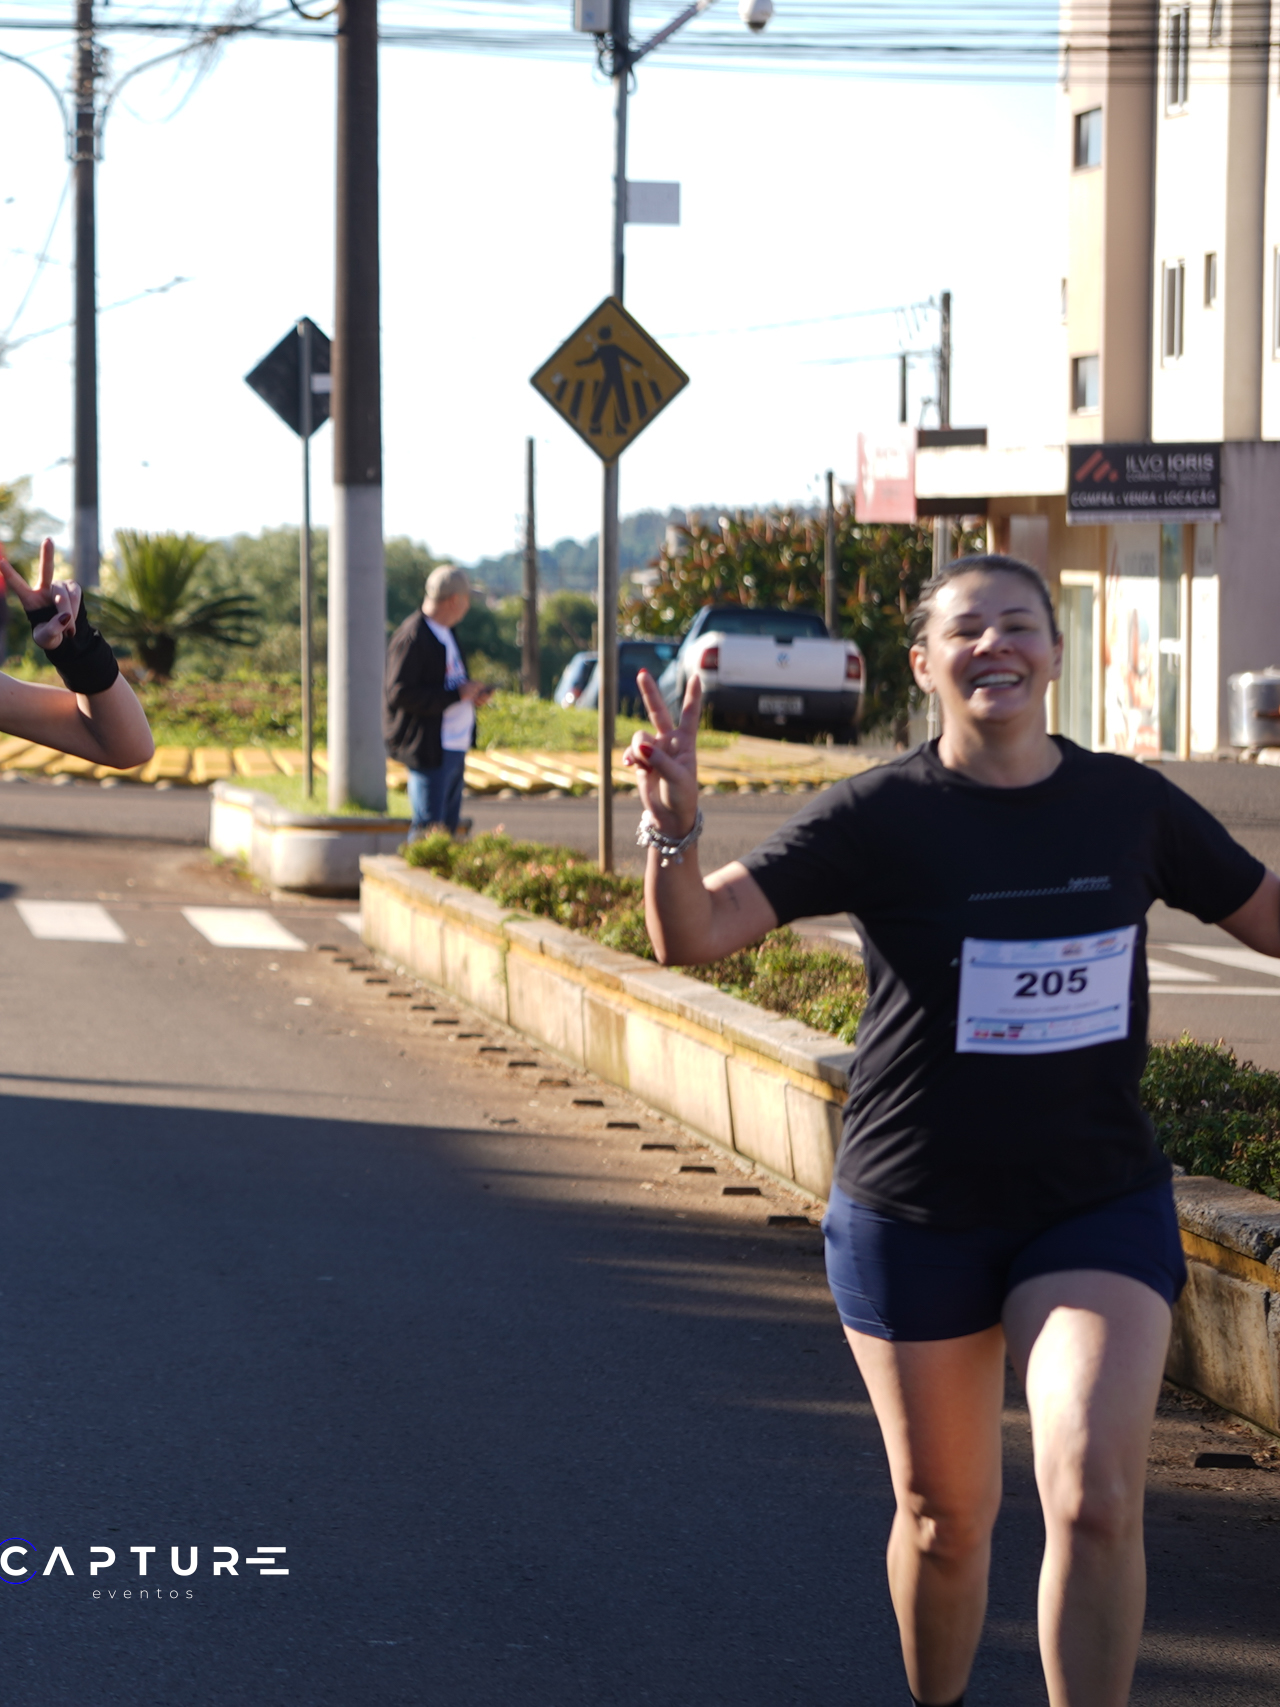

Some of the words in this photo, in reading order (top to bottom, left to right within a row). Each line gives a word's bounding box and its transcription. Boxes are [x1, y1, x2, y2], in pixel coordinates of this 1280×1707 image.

[1126, 454, 1162, 473] ILVO
[1168, 453, 1214, 472] IORIS
[1122, 490, 1158, 507] VENDA
[1164, 488, 1216, 507] LOCAÇÃO
[1014, 966, 1088, 999] 205
